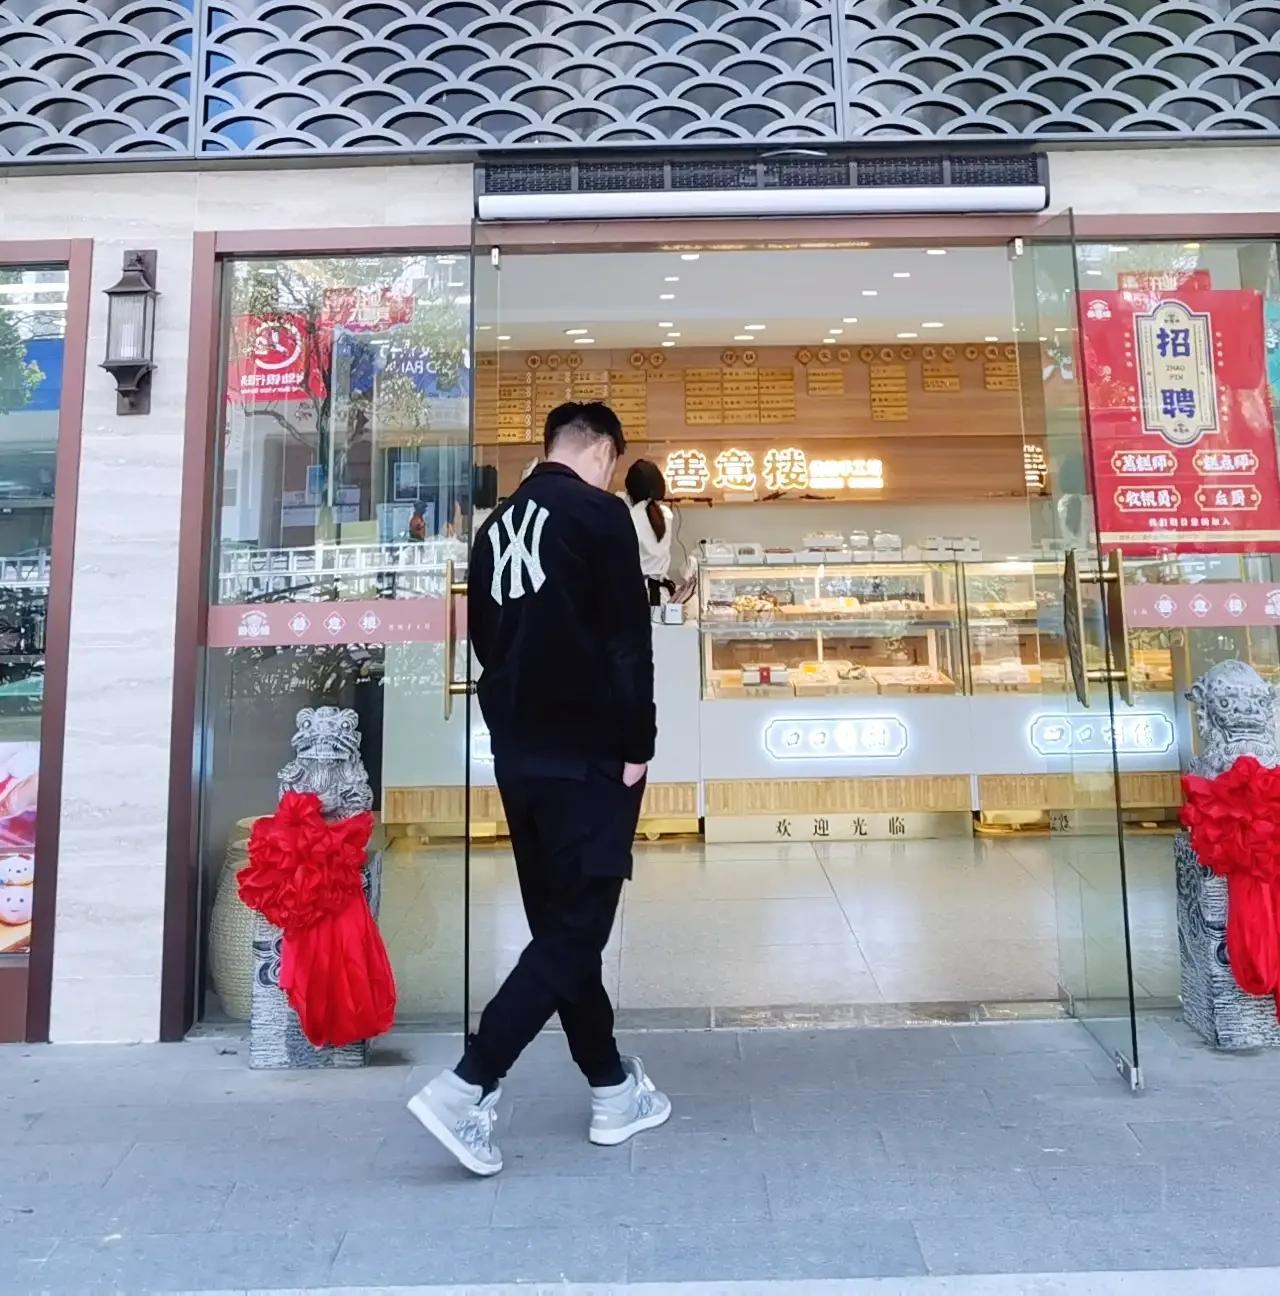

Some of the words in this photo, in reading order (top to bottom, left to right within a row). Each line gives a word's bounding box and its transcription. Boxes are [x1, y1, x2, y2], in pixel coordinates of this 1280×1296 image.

[664, 448, 808, 494] 善意楼
[776, 816, 906, 838] 欢迎光临
